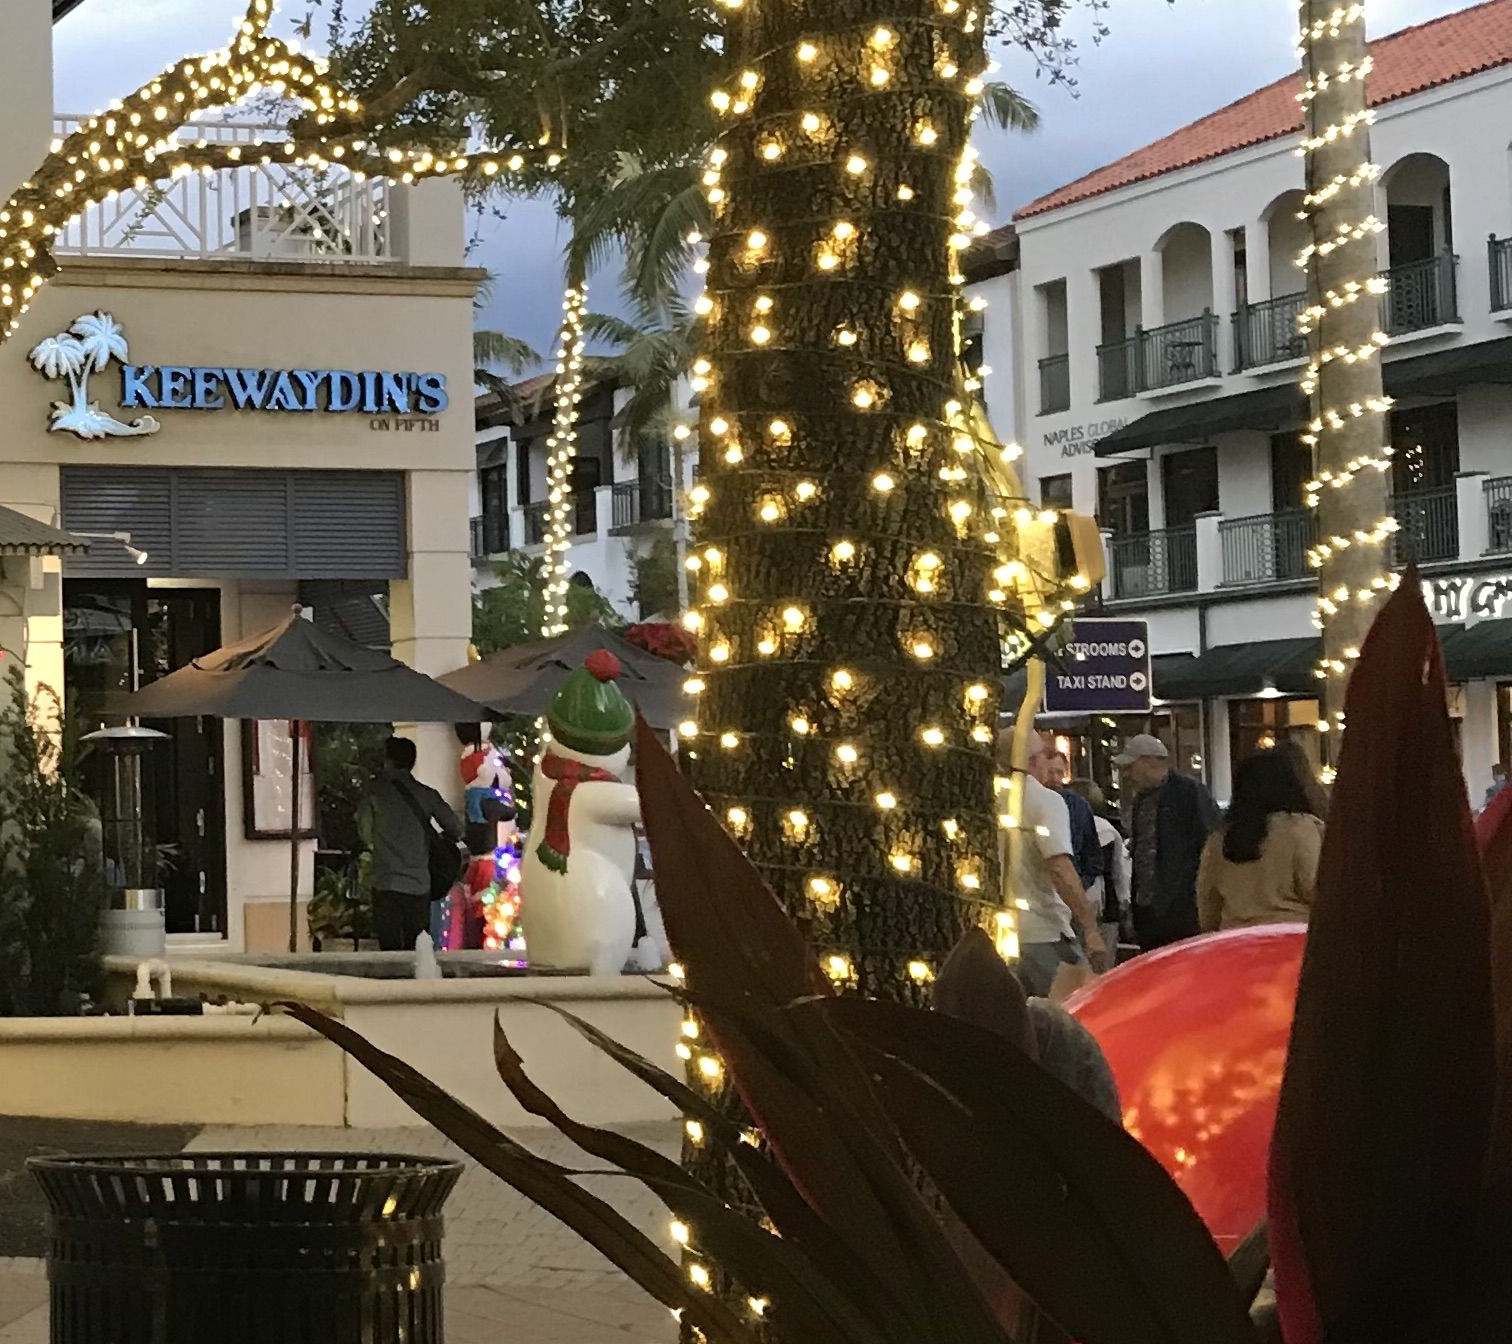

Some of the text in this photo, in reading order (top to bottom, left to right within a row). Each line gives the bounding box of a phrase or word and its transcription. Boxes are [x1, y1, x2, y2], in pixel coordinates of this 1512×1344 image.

[120, 364, 450, 415] KEEWAYDIN'S
[369, 418, 440, 432] ON FIFTH
[1043, 425, 1085, 446] NAPLES
[1061, 439, 1099, 458] ADVIS
[1054, 642, 1127, 657] STROOMS
[1056, 674, 1127, 689] TAXI STAND
